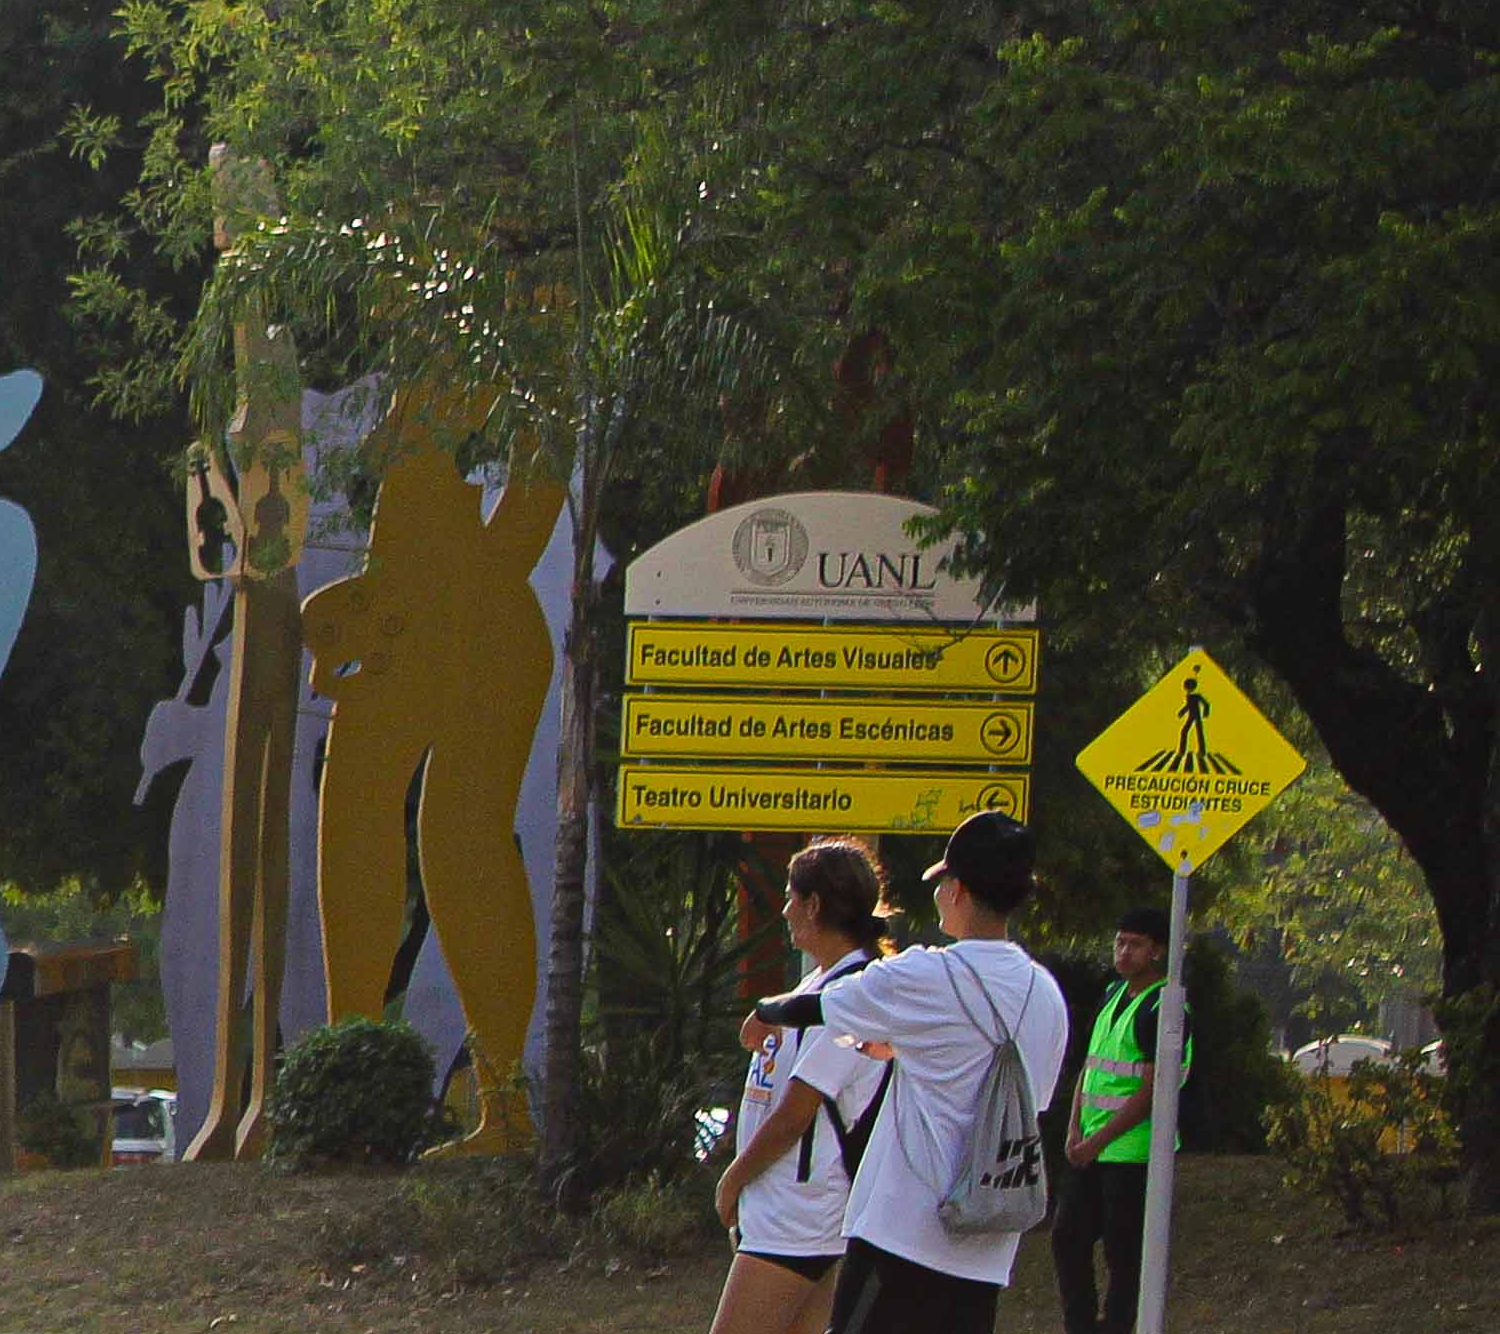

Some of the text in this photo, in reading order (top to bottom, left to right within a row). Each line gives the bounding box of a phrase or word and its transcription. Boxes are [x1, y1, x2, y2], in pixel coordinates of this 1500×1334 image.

[817, 552, 937, 589] UANL
[639, 643, 937, 670] Facultad de Artes Visuales
[635, 714, 954, 741] Facultad de Artes Escénicas
[632, 785, 852, 811] Teatro Universitario
[1105, 774, 1271, 796] PRECAUCIÓN CRUCE
